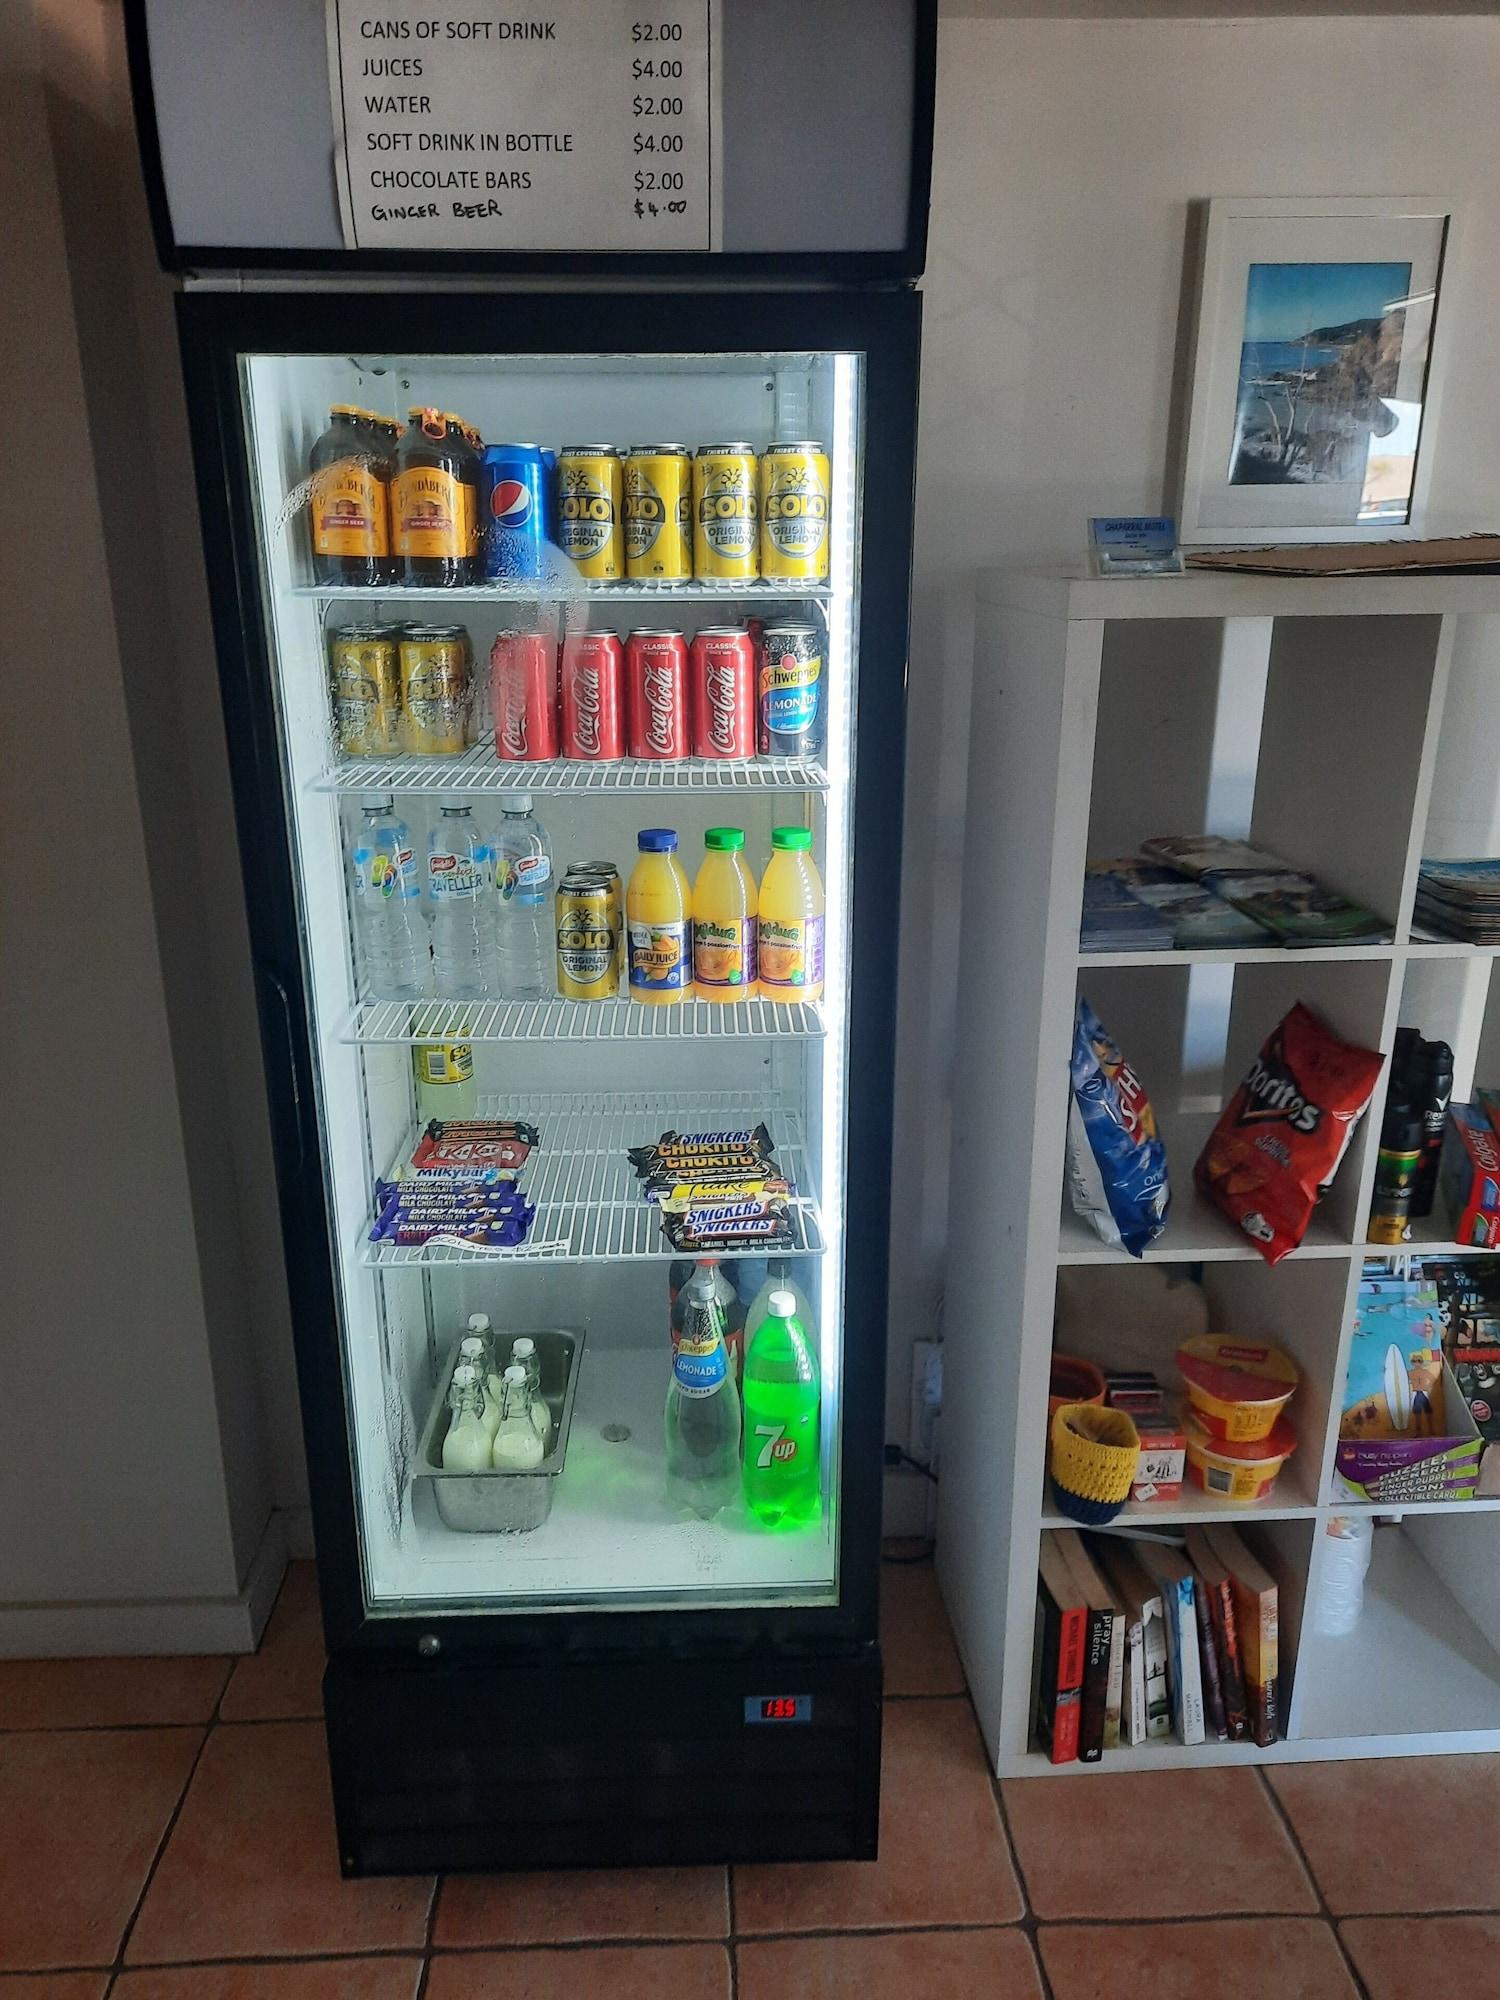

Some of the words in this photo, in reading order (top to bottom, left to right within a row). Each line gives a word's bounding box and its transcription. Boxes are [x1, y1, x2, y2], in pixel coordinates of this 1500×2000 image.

[360, 21, 410, 40] CANS
[416, 22, 440, 39] OF
[446, 22, 492, 39] SOFT
[499, 23, 556, 40] DRINK
[631, 23, 682, 42] $2.00
[362, 59, 423, 76] JUICES
[632, 60, 682, 80] $4.00
[365, 96, 431, 114] WATER
[632, 97, 683, 117] $2.00
[367, 133, 413, 151] SOFT
[419, 134, 476, 152] DRINK
[481, 134, 499, 151] IN
[505, 135, 574, 152] BOTTLE
[633, 135, 683, 154] $4.00
[370, 171, 480, 189] CHOCOLATE
[485, 171, 532, 189] BARS
[634, 172, 684, 192] $2.00
[371, 204, 440, 221] GINGER
[453, 199, 503, 219] BEER
[633, 199, 687, 218] $4.00
[562, 497, 610, 521] OLO
[703, 495, 758, 520] SOLO
[768, 495, 825, 519] SOLO
[715, 536, 752, 545] LEMON
[763, 695, 817, 712] LEMONADE
[558, 931, 611, 950] SOLO
[562, 955, 608, 964] ORIGINAL
[655, 950, 678, 963] JUICE
[568, 964, 603, 972] LEMON
[1243, 1060, 1320, 1130] Doritos
[682, 1131, 751, 1144] SNICKERS
[658, 1143, 745, 1157] CHOKITO
[1469, 1130, 1499, 1172] Colgate
[666, 1156, 754, 1169] CHOKITO
[687, 1201, 763, 1223] SNICKERS
[398, 1224, 437, 1232] DAIRY
[437, 1223, 468, 1231] MILK
[694, 1219, 770, 1233] SNICKERS
[677, 1359, 717, 1376] LEMONADE
[1379, 1454, 1448, 1481] PUZZLES
[1379, 1464, 1447, 1486] STICKERS
[1379, 1479, 1413, 1491] FINGER
[1380, 1482, 1445, 1496] CRAYONS
[1380, 1491, 1431, 1501] COLLECTIBLE
[1101, 1614, 1112, 1645] pray
[1091, 1622, 1102, 1665] silence
